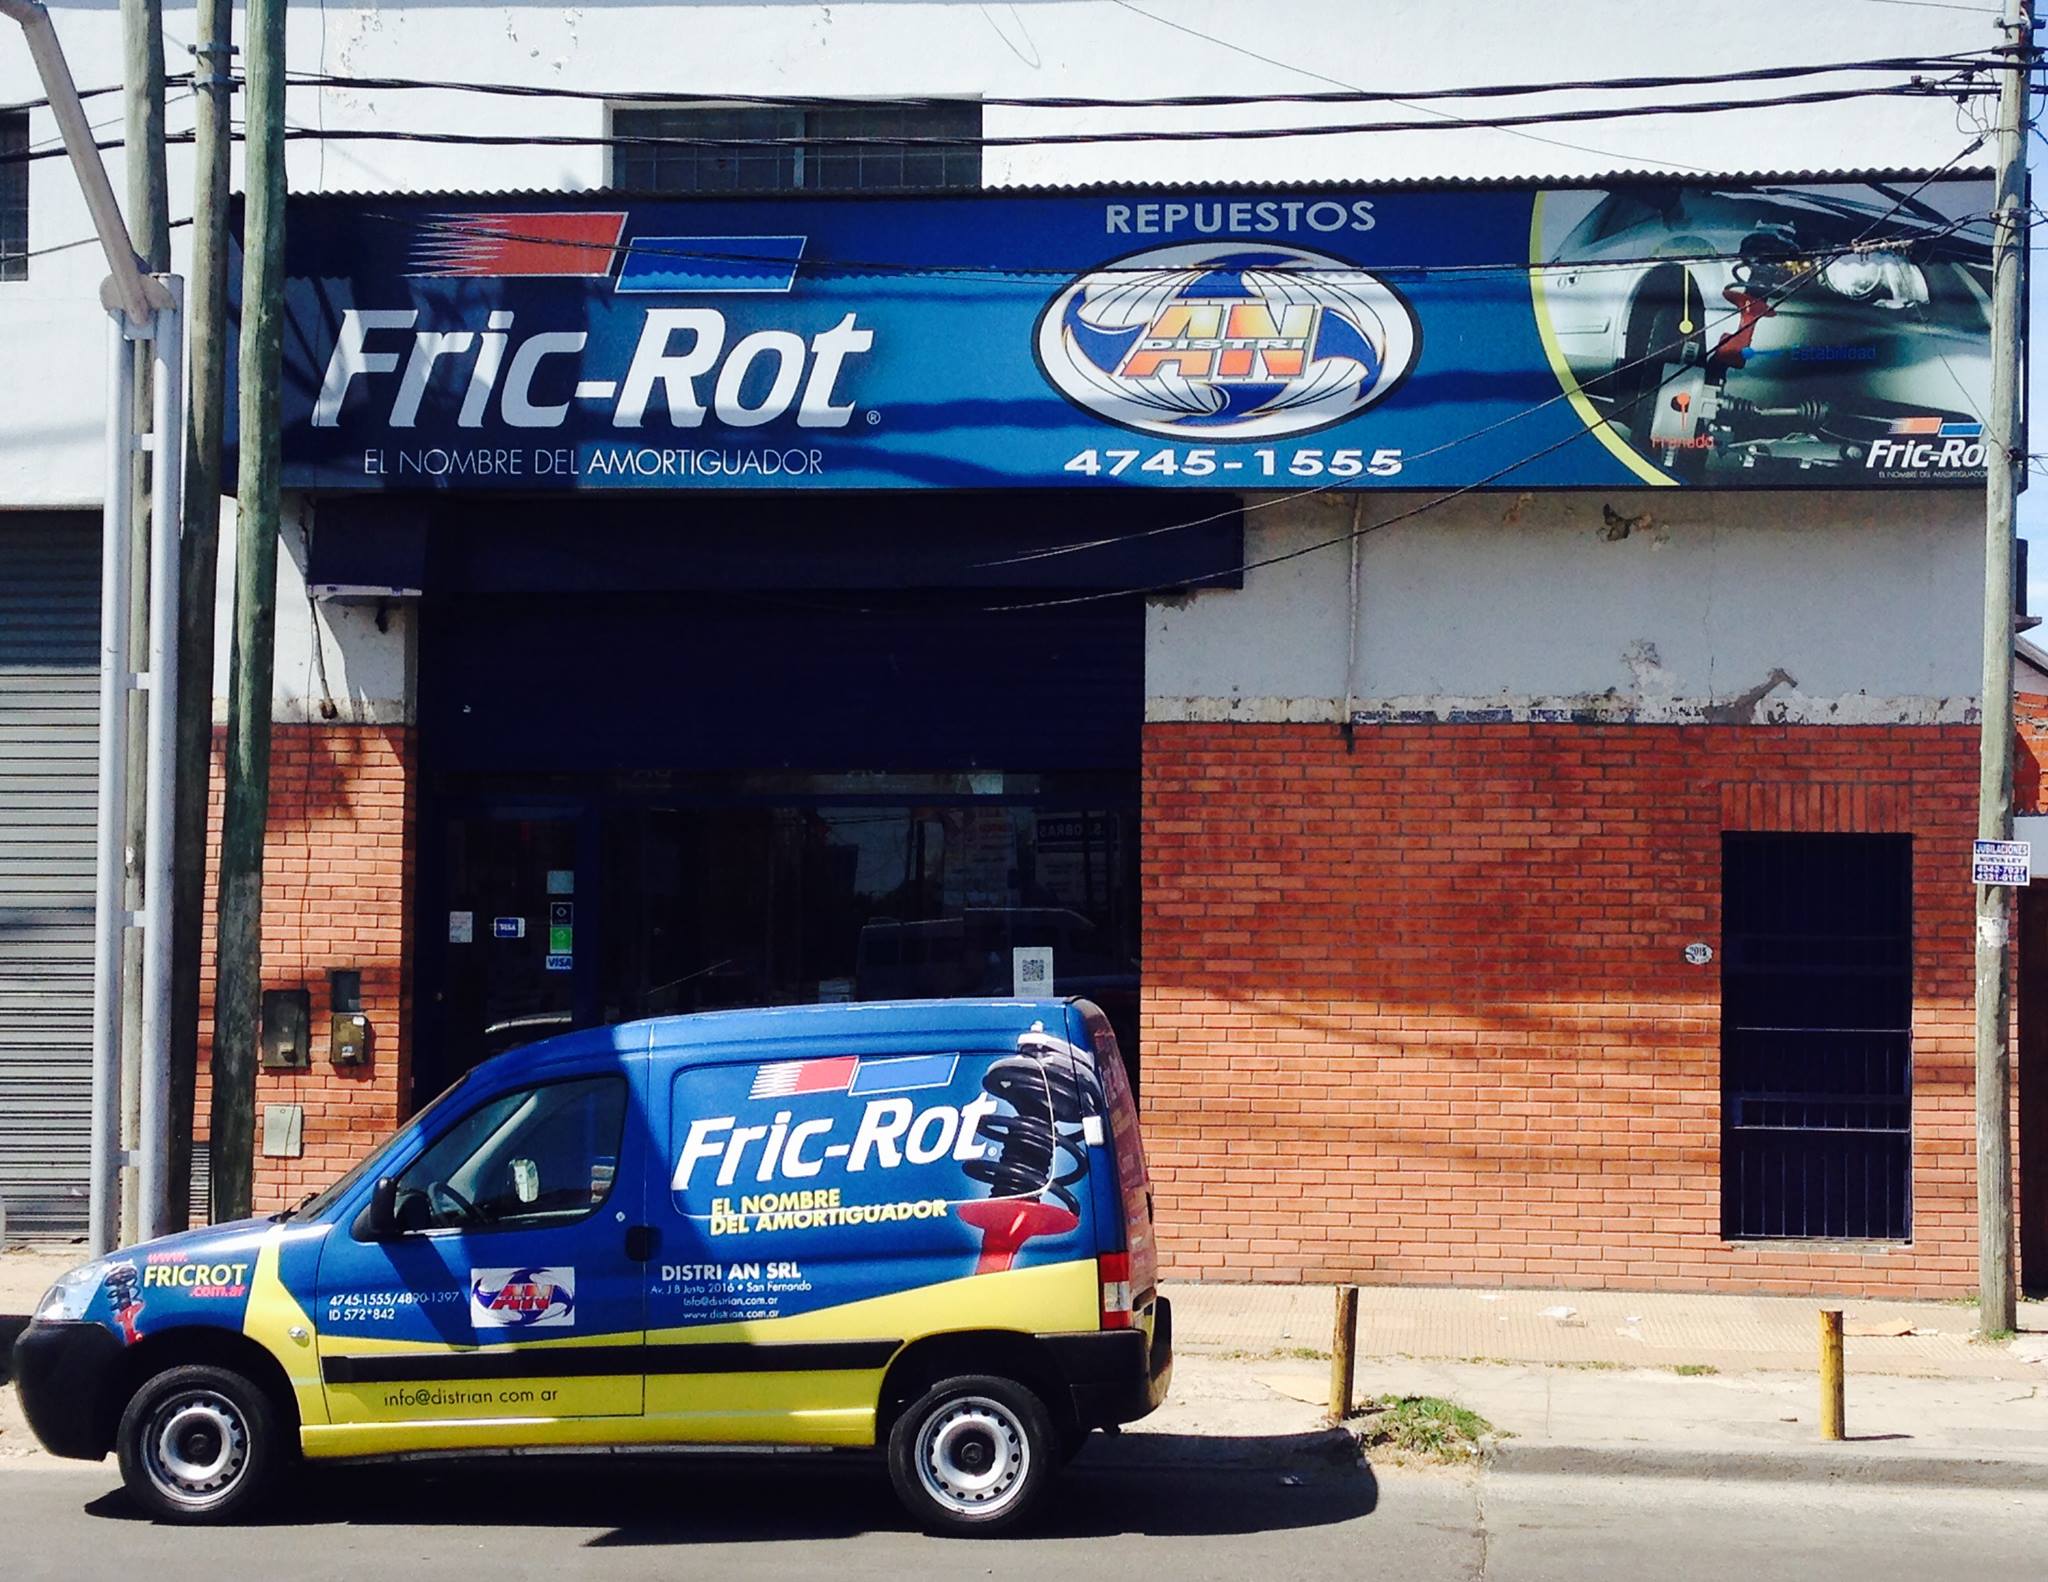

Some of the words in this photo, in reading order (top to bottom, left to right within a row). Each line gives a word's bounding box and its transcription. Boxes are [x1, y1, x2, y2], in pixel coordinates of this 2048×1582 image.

[1106, 201, 1376, 234] REPUESTOS
[1146, 337, 1306, 350] DISTRI
[310, 308, 874, 428] Fric-Rot
[364, 448, 390, 476] EL
[399, 448, 523, 476] NOMBRE
[534, 448, 579, 476] DEL
[587, 448, 823, 476] AMORTIGUADOR
[1064, 448, 1402, 476] 4745-1555
[1976, 843, 2027, 855] JUBILACIONES
[548, 957, 571, 968] VISA
[670, 1093, 998, 1191] Fric-Rot
[711, 1197, 737, 1218] EL
[740, 1189, 840, 1215] NOMBRE
[710, 1215, 750, 1236] DEL
[756, 1200, 948, 1234] AMORTIGUADOR
[143, 1263, 249, 1288] FRICROT
[661, 1264, 723, 1282] DISTRI
[727, 1262, 760, 1280] AN
[766, 1261, 802, 1280] SRL
[708, 1283, 735, 1293] 2016
[746, 1281, 765, 1293] San
[767, 1280, 813, 1292] Fernando
[328, 1309, 341, 1321] ID
